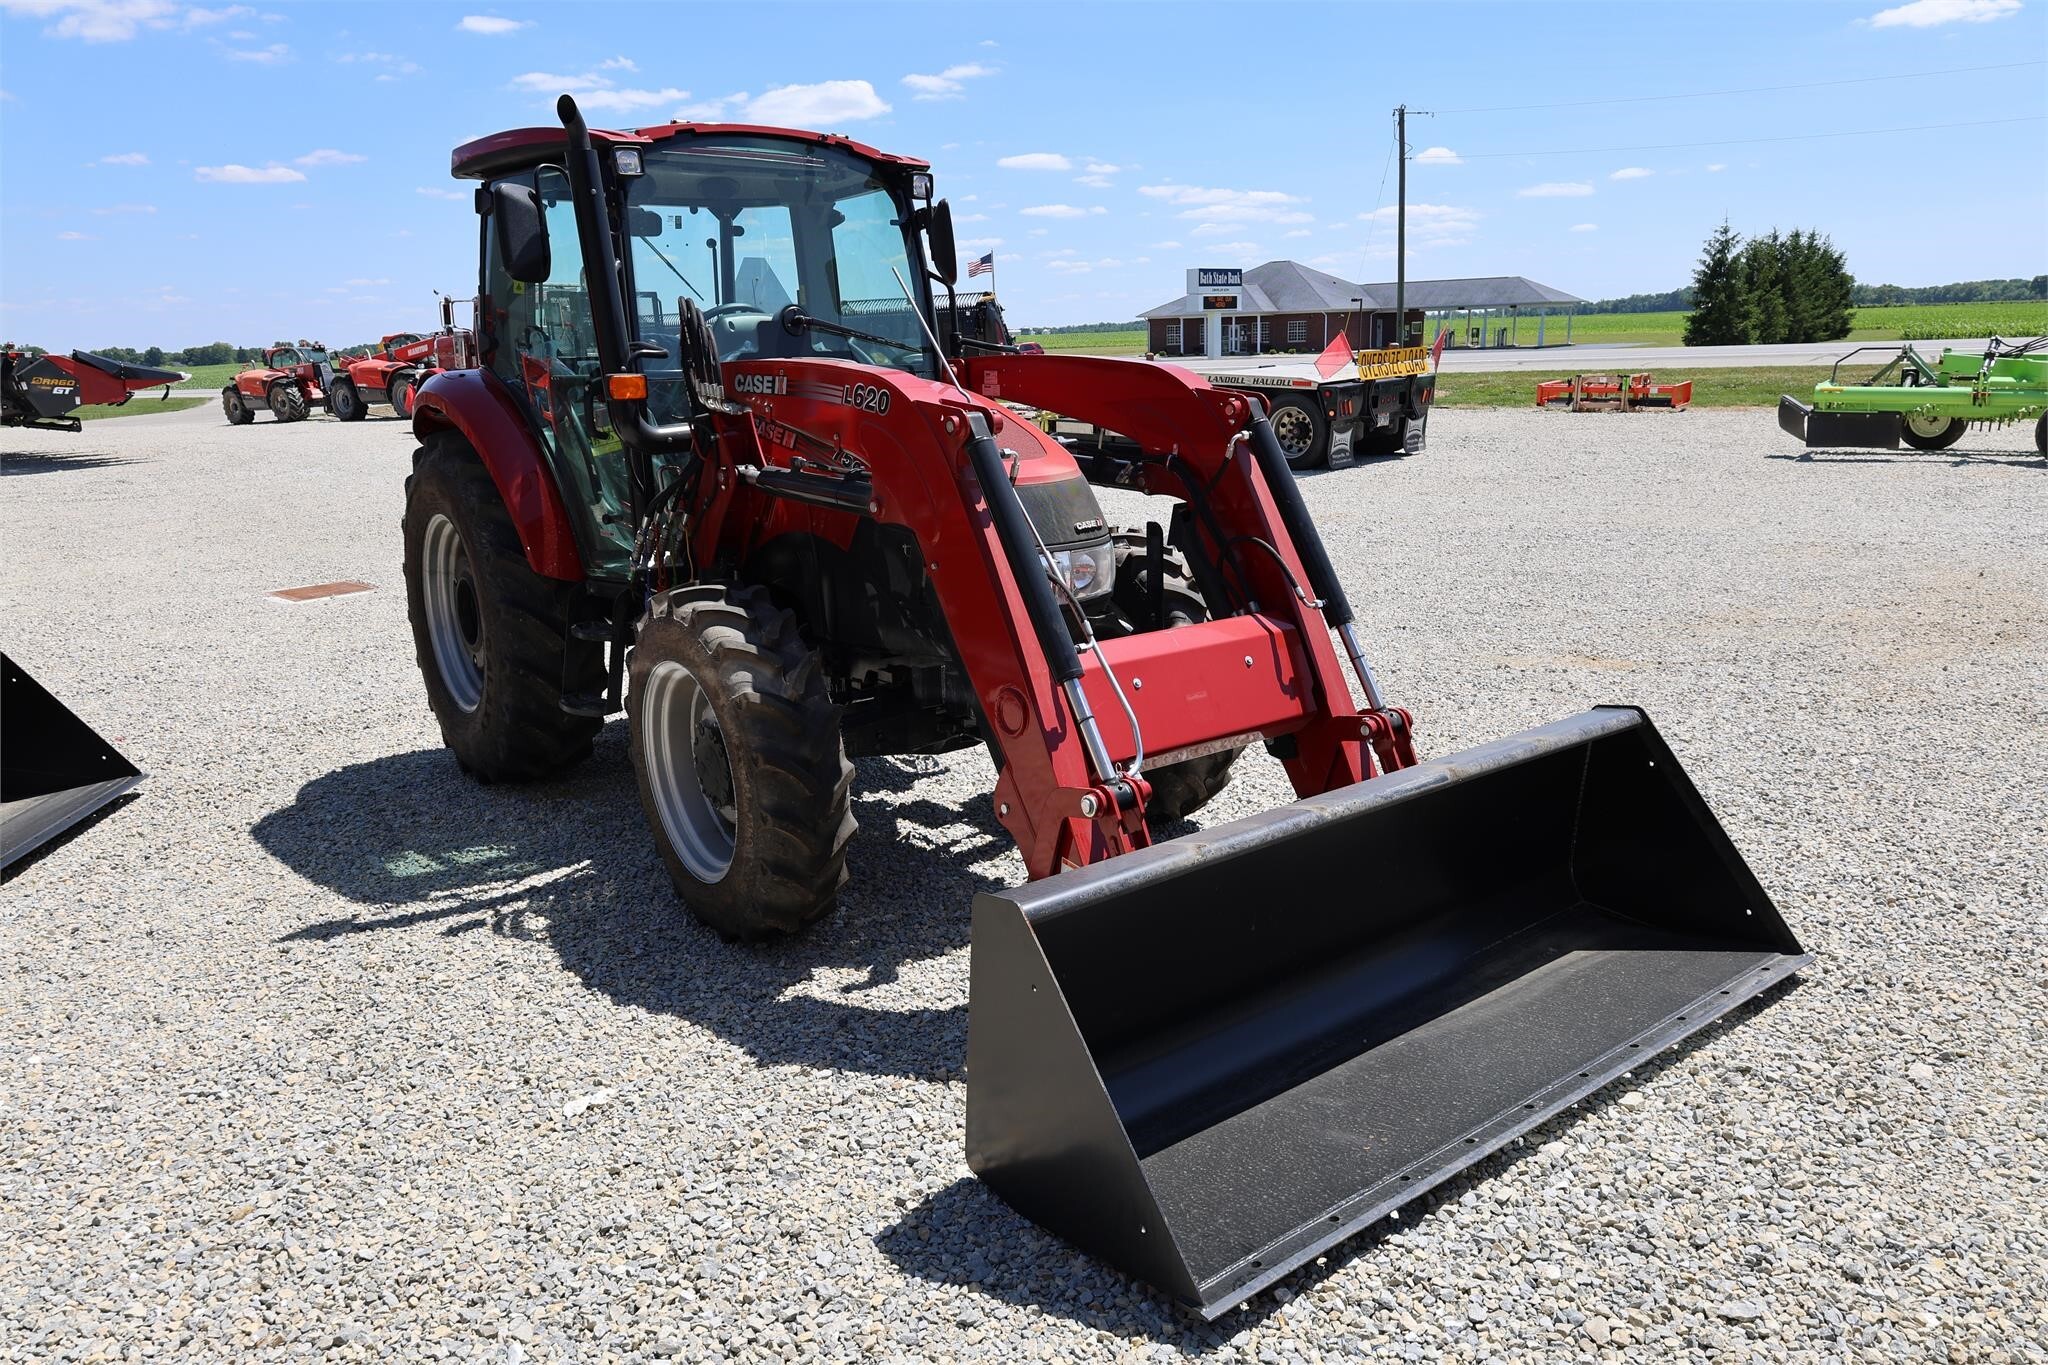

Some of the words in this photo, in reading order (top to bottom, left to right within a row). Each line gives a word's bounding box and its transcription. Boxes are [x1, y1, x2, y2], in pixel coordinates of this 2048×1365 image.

[1199, 271, 1213, 285] Bath
[1212, 271, 1228, 285] State
[1227, 271, 1241, 285] Bank
[1361, 351, 1403, 378] OVERSIZE
[1403, 348, 1426, 373] LOAD
[31, 376, 76, 386] DRAGO
[734, 375, 773, 394] CASE
[1207, 375, 1246, 385] LANDOLL
[1252, 377, 1292, 387] HAULOLL
[52, 386, 74, 395] GT
[842, 382, 891, 416] L620
[1075, 519, 1097, 530] CASE
